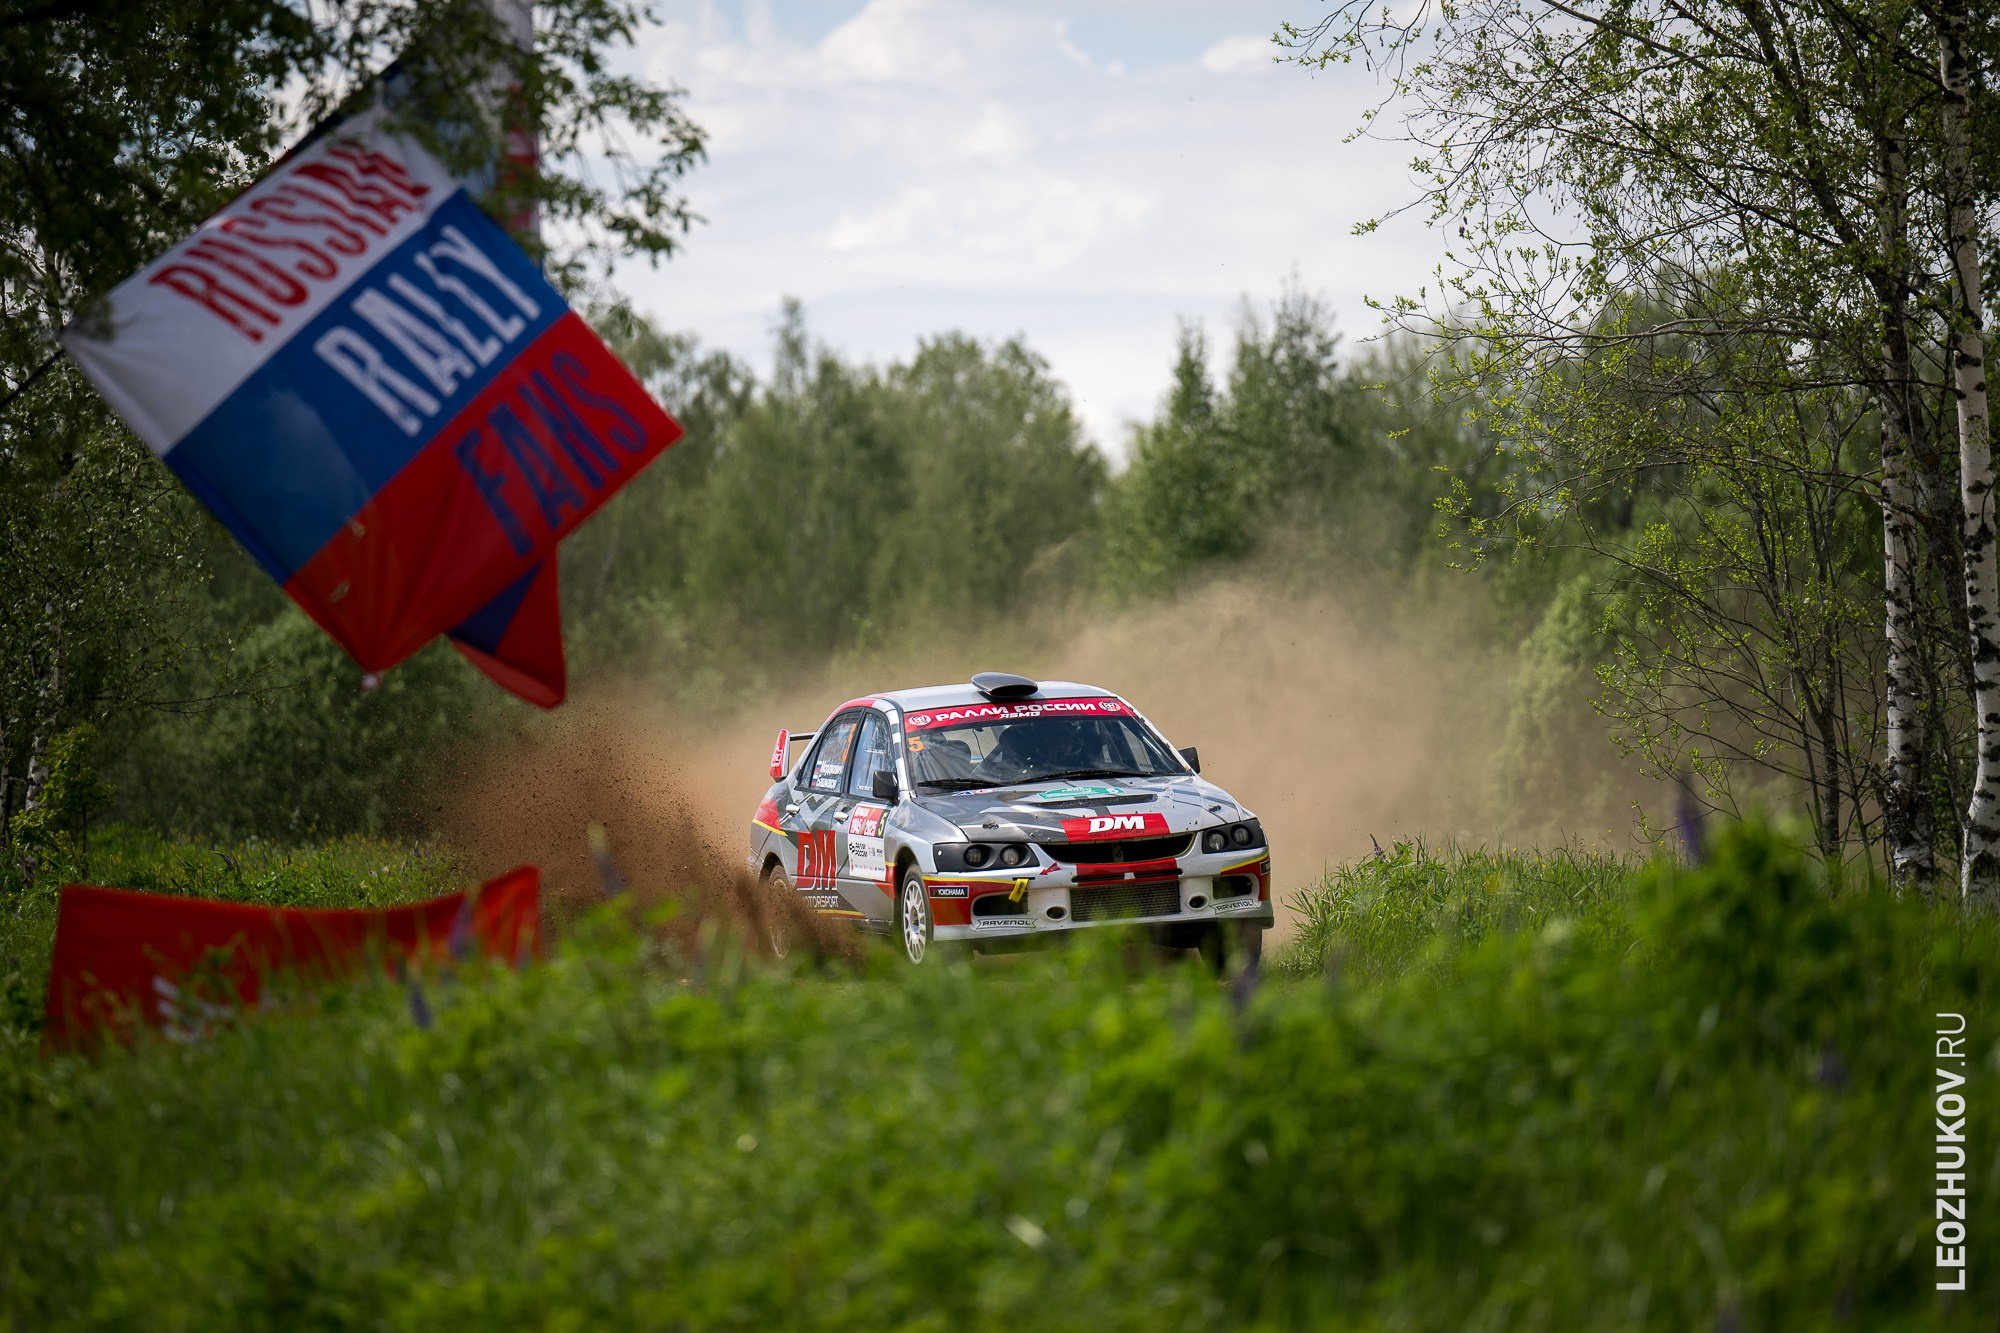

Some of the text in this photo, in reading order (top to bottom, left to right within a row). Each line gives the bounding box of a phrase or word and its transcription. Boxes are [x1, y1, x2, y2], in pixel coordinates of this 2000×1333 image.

[313, 224, 542, 437] RALLY
[454, 351, 649, 557] FANS
[936, 706, 1010, 722] РАЛЛИ
[1013, 701, 1097, 715] РОССИИ
[908, 736, 924, 752] 5
[877, 811, 889, 836] 5
[1089, 815, 1147, 833] DM
[796, 829, 838, 891] DM
[938, 888, 966, 896] YOKOHAMA
[1216, 900, 1254, 911] RAVENOL
